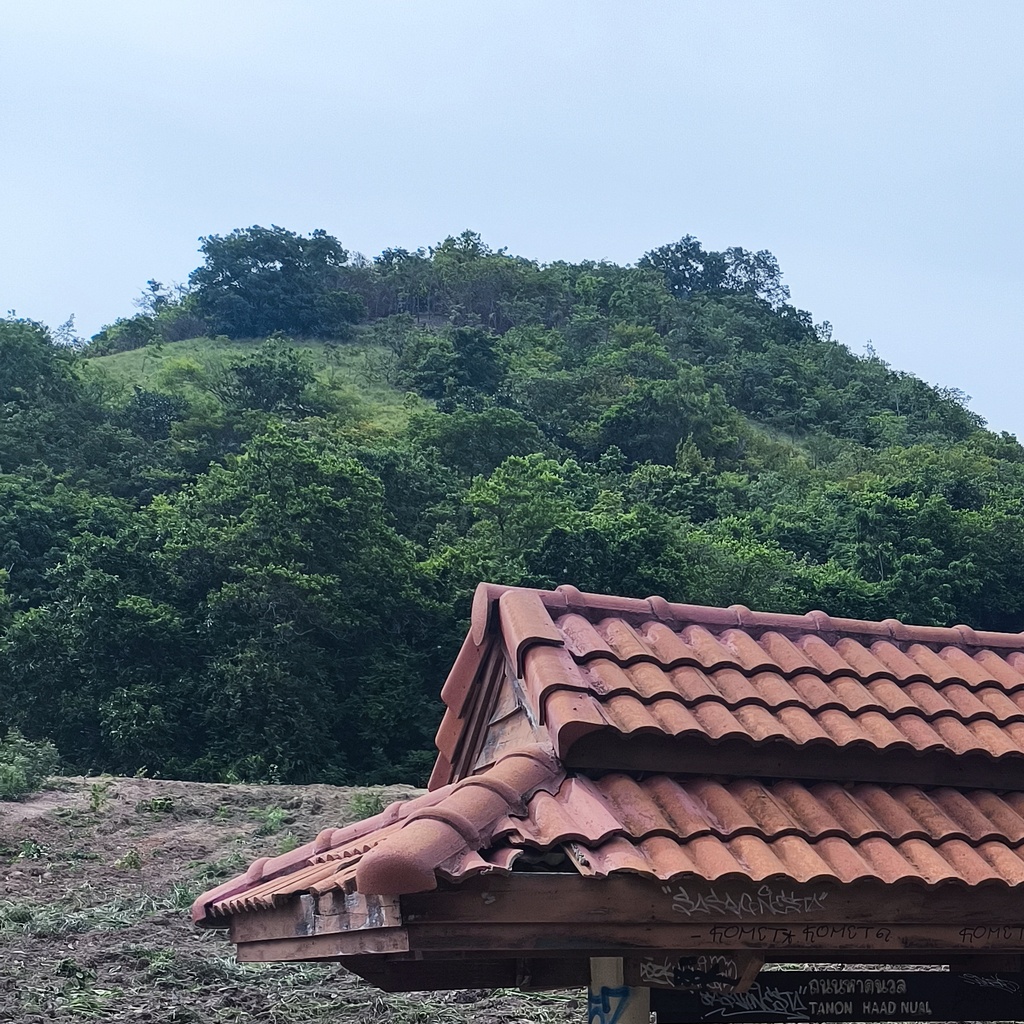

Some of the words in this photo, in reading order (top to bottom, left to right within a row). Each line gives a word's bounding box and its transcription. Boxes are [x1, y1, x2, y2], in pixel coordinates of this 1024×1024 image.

[809, 978, 907, 995] ถนนหาดนวล
[809, 1001, 853, 1015] TANON
[862, 1001, 897, 1015] HAAD
